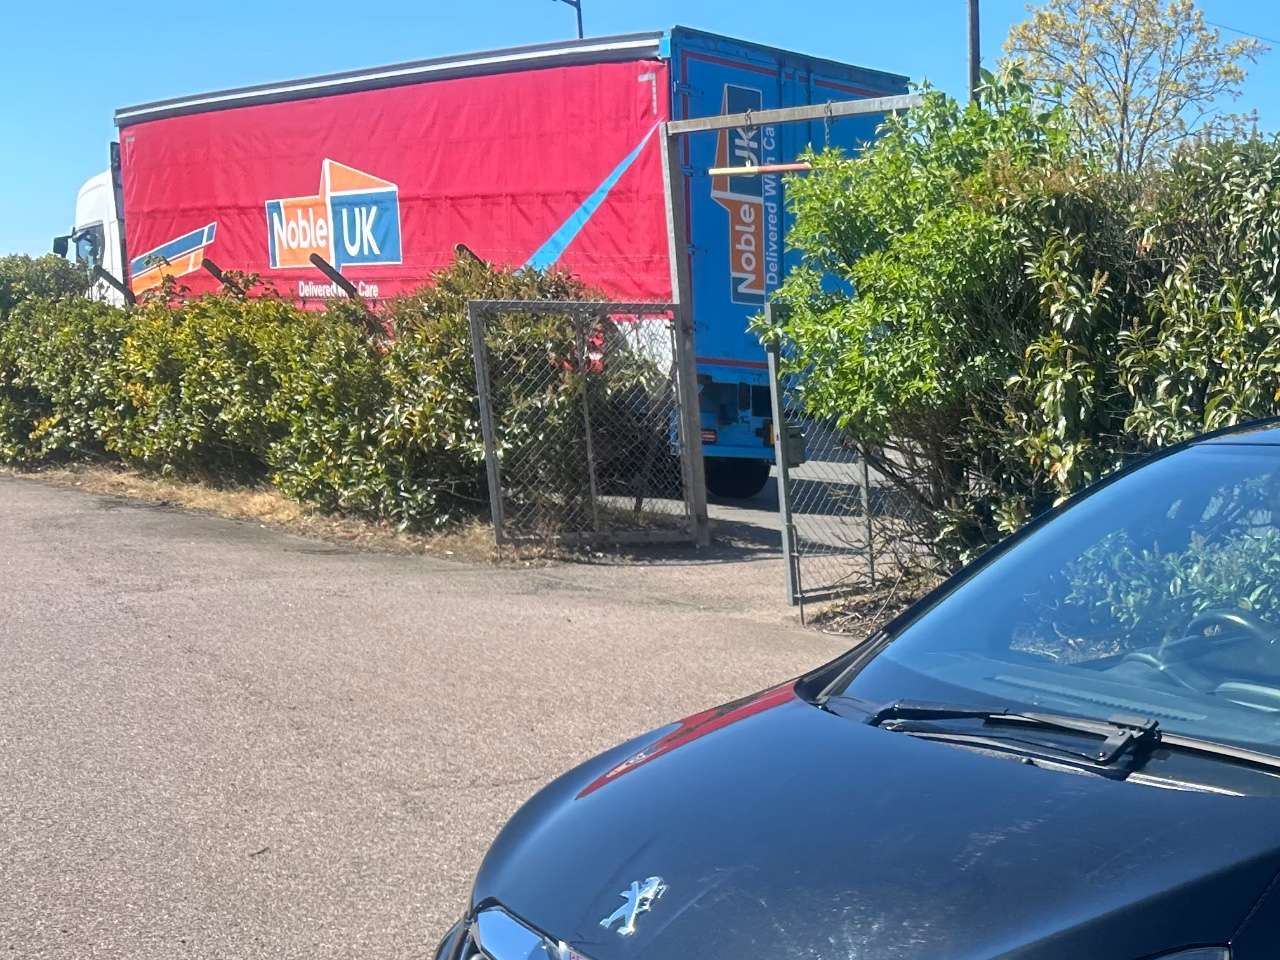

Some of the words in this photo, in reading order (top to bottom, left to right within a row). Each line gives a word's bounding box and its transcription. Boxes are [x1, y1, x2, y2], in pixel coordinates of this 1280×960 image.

[273, 206, 328, 250] Noble
[342, 206, 381, 257] UK
[735, 204, 764, 295] Noble
[764, 201, 778, 285] Delivered
[298, 280, 336, 297] Delivered
[358, 280, 379, 298] Care
